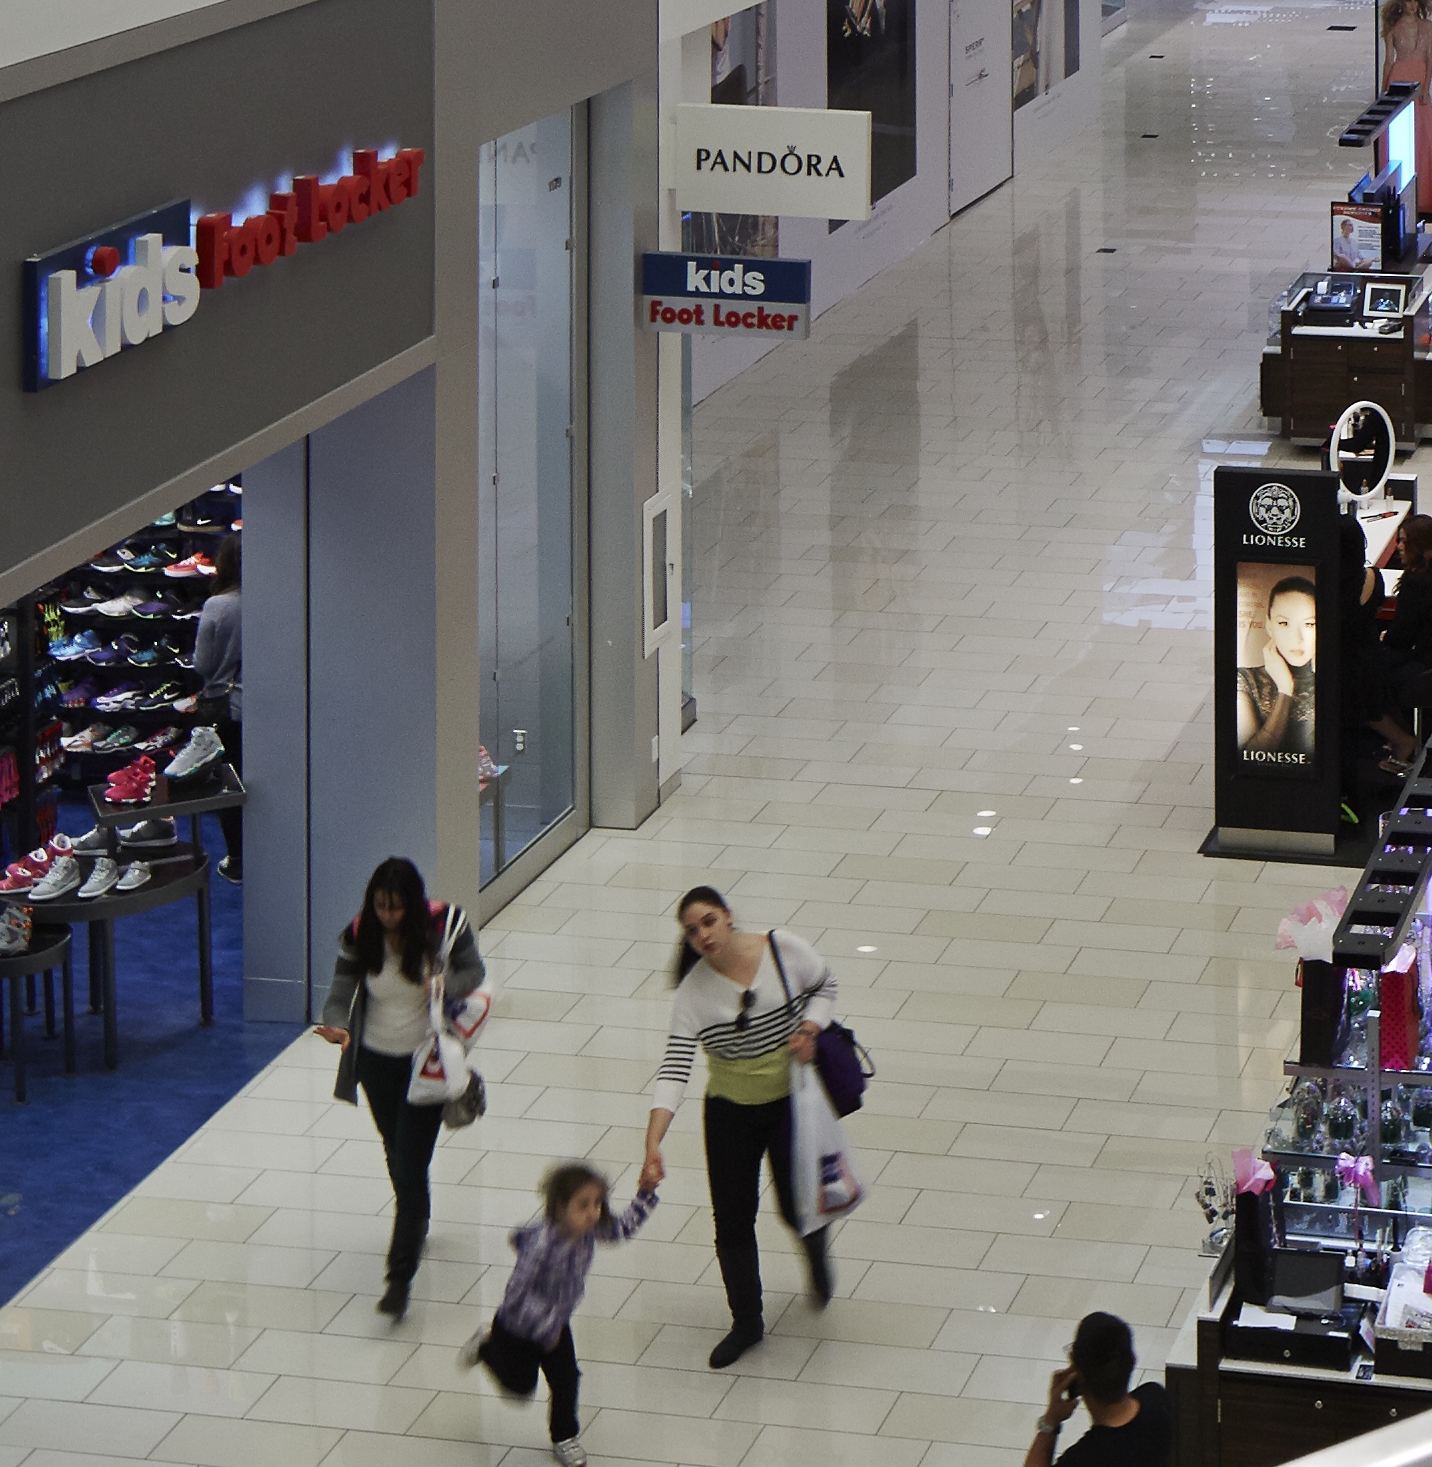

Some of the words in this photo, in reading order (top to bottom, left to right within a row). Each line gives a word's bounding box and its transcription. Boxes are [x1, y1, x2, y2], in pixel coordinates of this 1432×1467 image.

[47, 232, 201, 381] kids
[196, 191, 298, 289] Foot
[292, 147, 425, 244] Locker
[686, 259, 766, 296] kids
[649, 299, 705, 326] Foot
[713, 304, 799, 331] Locker
[1242, 533, 1306, 548] LIONESSE
[1242, 749, 1306, 764] LIONESSE
